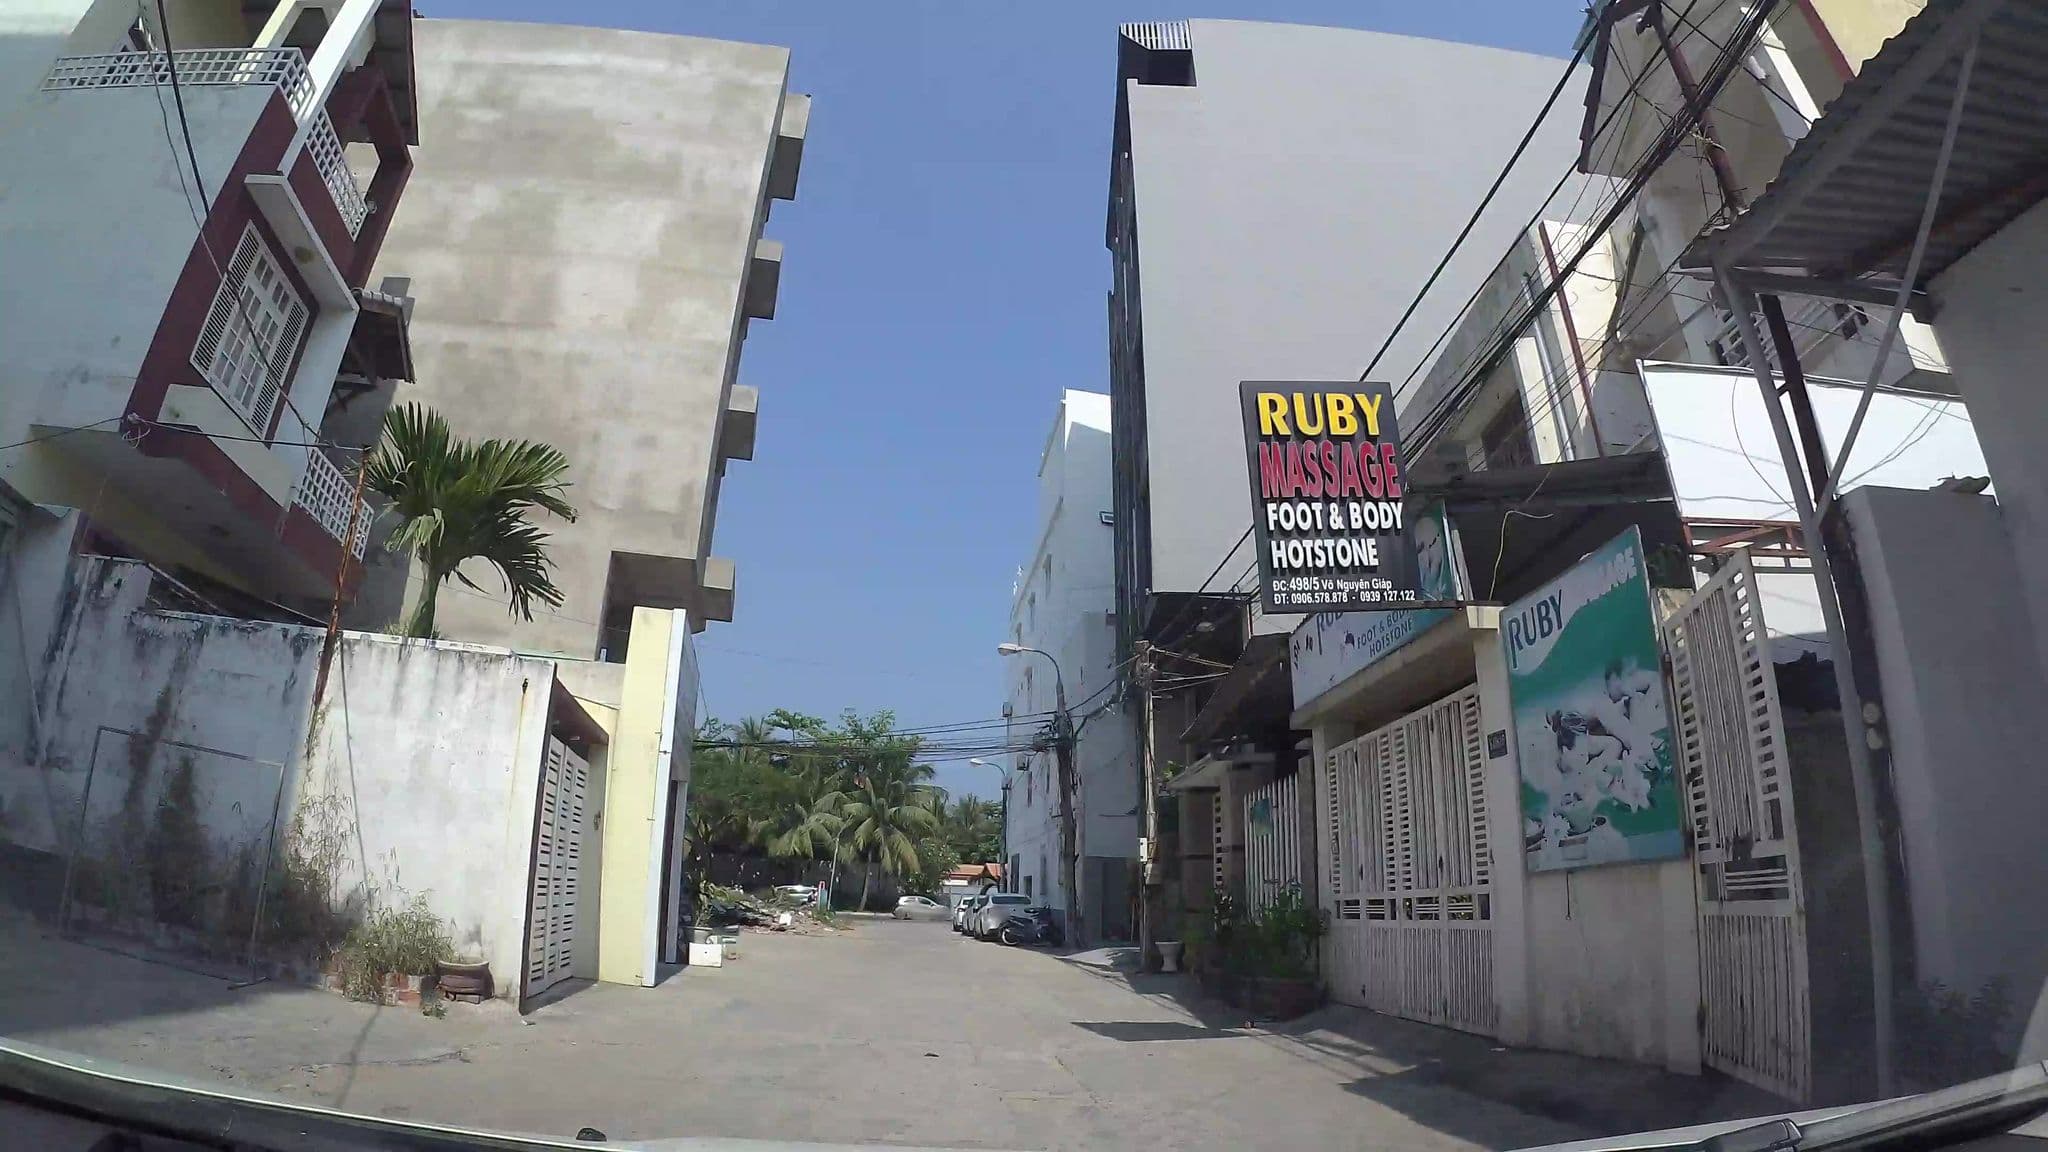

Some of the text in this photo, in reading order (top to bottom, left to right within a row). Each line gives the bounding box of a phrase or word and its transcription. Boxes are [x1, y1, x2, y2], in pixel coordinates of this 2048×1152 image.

[1257, 392, 1382, 436] RUBY
[1259, 440, 1402, 498] MASSAGE
[1267, 502, 1403, 531] FOOT & BODY
[1271, 538, 1379, 568] HOTSTONE
[1291, 591, 1348, 604] 0906.578.878
[1357, 625, 1377, 649] FOOT
[1386, 609, 1410, 628] BOD
[1507, 589, 1563, 669] RUBY
